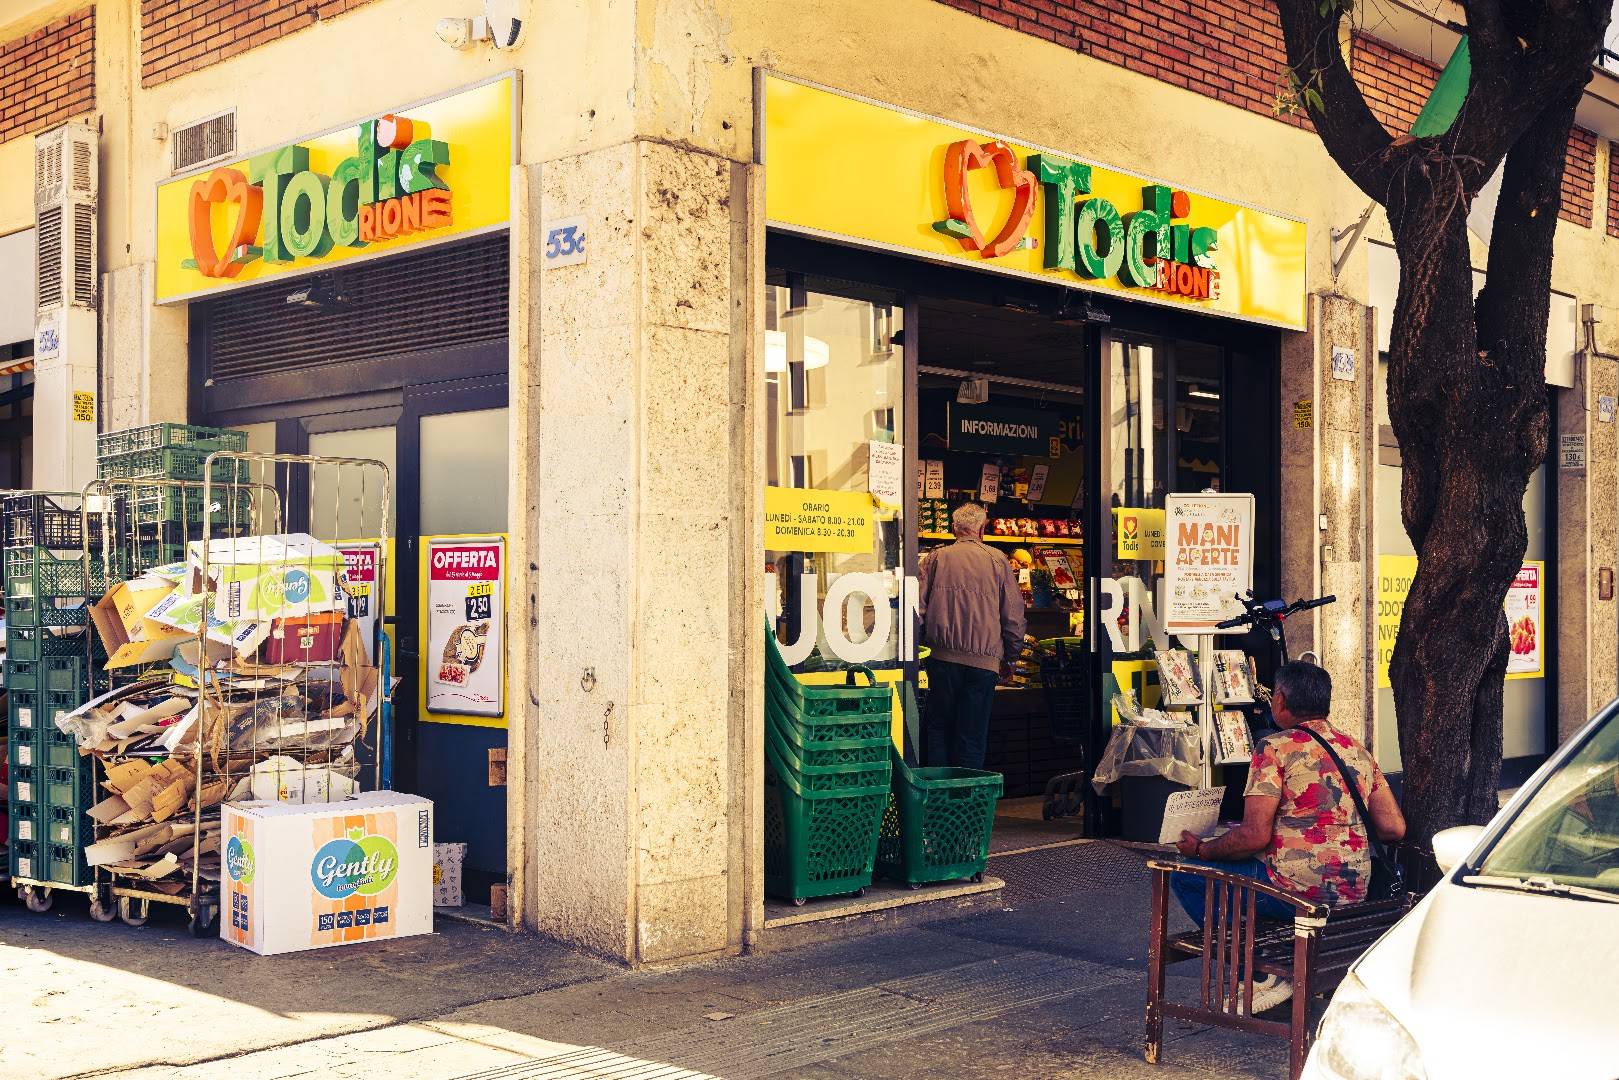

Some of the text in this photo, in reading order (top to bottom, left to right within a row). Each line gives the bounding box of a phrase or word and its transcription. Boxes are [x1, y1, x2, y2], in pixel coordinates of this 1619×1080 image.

[359, 188, 453, 243] RIONE
[1156, 257, 1221, 300] RIONE
[961, 419, 1038, 439] INFORMAZIONI
[802, 502, 830, 513] ORARIO
[797, 514, 826, 525] SABATO
[827, 516, 842, 526] 8.00
[846, 517, 865, 526] 21.00
[775, 525, 815, 536] DOMENICA
[836, 528, 855, 538] 20.30
[1177, 522, 1240, 548] MANI
[1122, 540, 1139, 551] Todis
[433, 550, 497, 569] OFFERTA
[1175, 547, 1240, 566] APERTE
[1382, 577, 1393, 593] DI
[228, 846, 254, 875] Gently
[317, 850, 395, 887] Gently
[320, 915, 334, 925] 150
